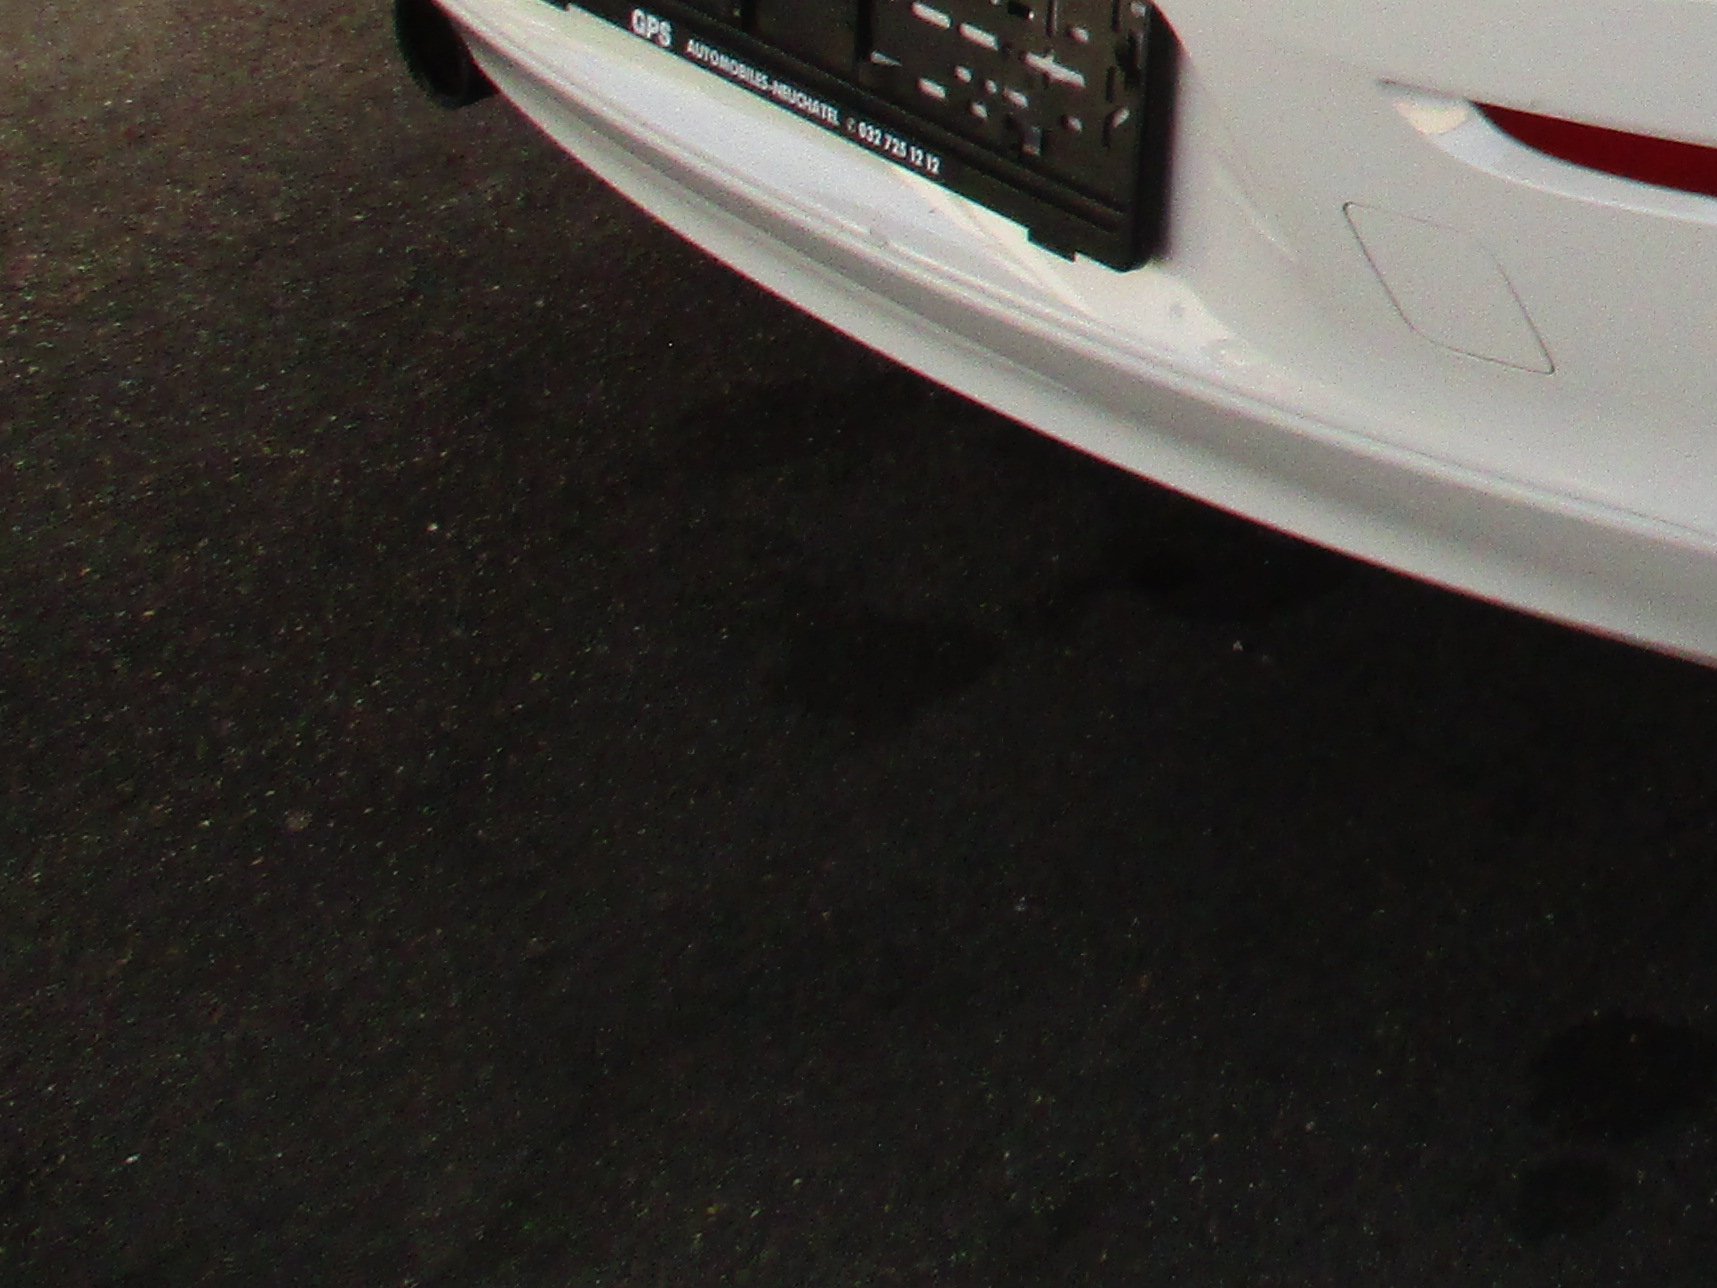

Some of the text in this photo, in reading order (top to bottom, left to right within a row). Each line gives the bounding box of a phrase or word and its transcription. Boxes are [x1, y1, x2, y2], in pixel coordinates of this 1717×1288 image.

[630, 7, 673, 48] GPS
[857, 120, 882, 145] 032
[908, 144, 924, 167] 12
[924, 153, 942, 175] 12
